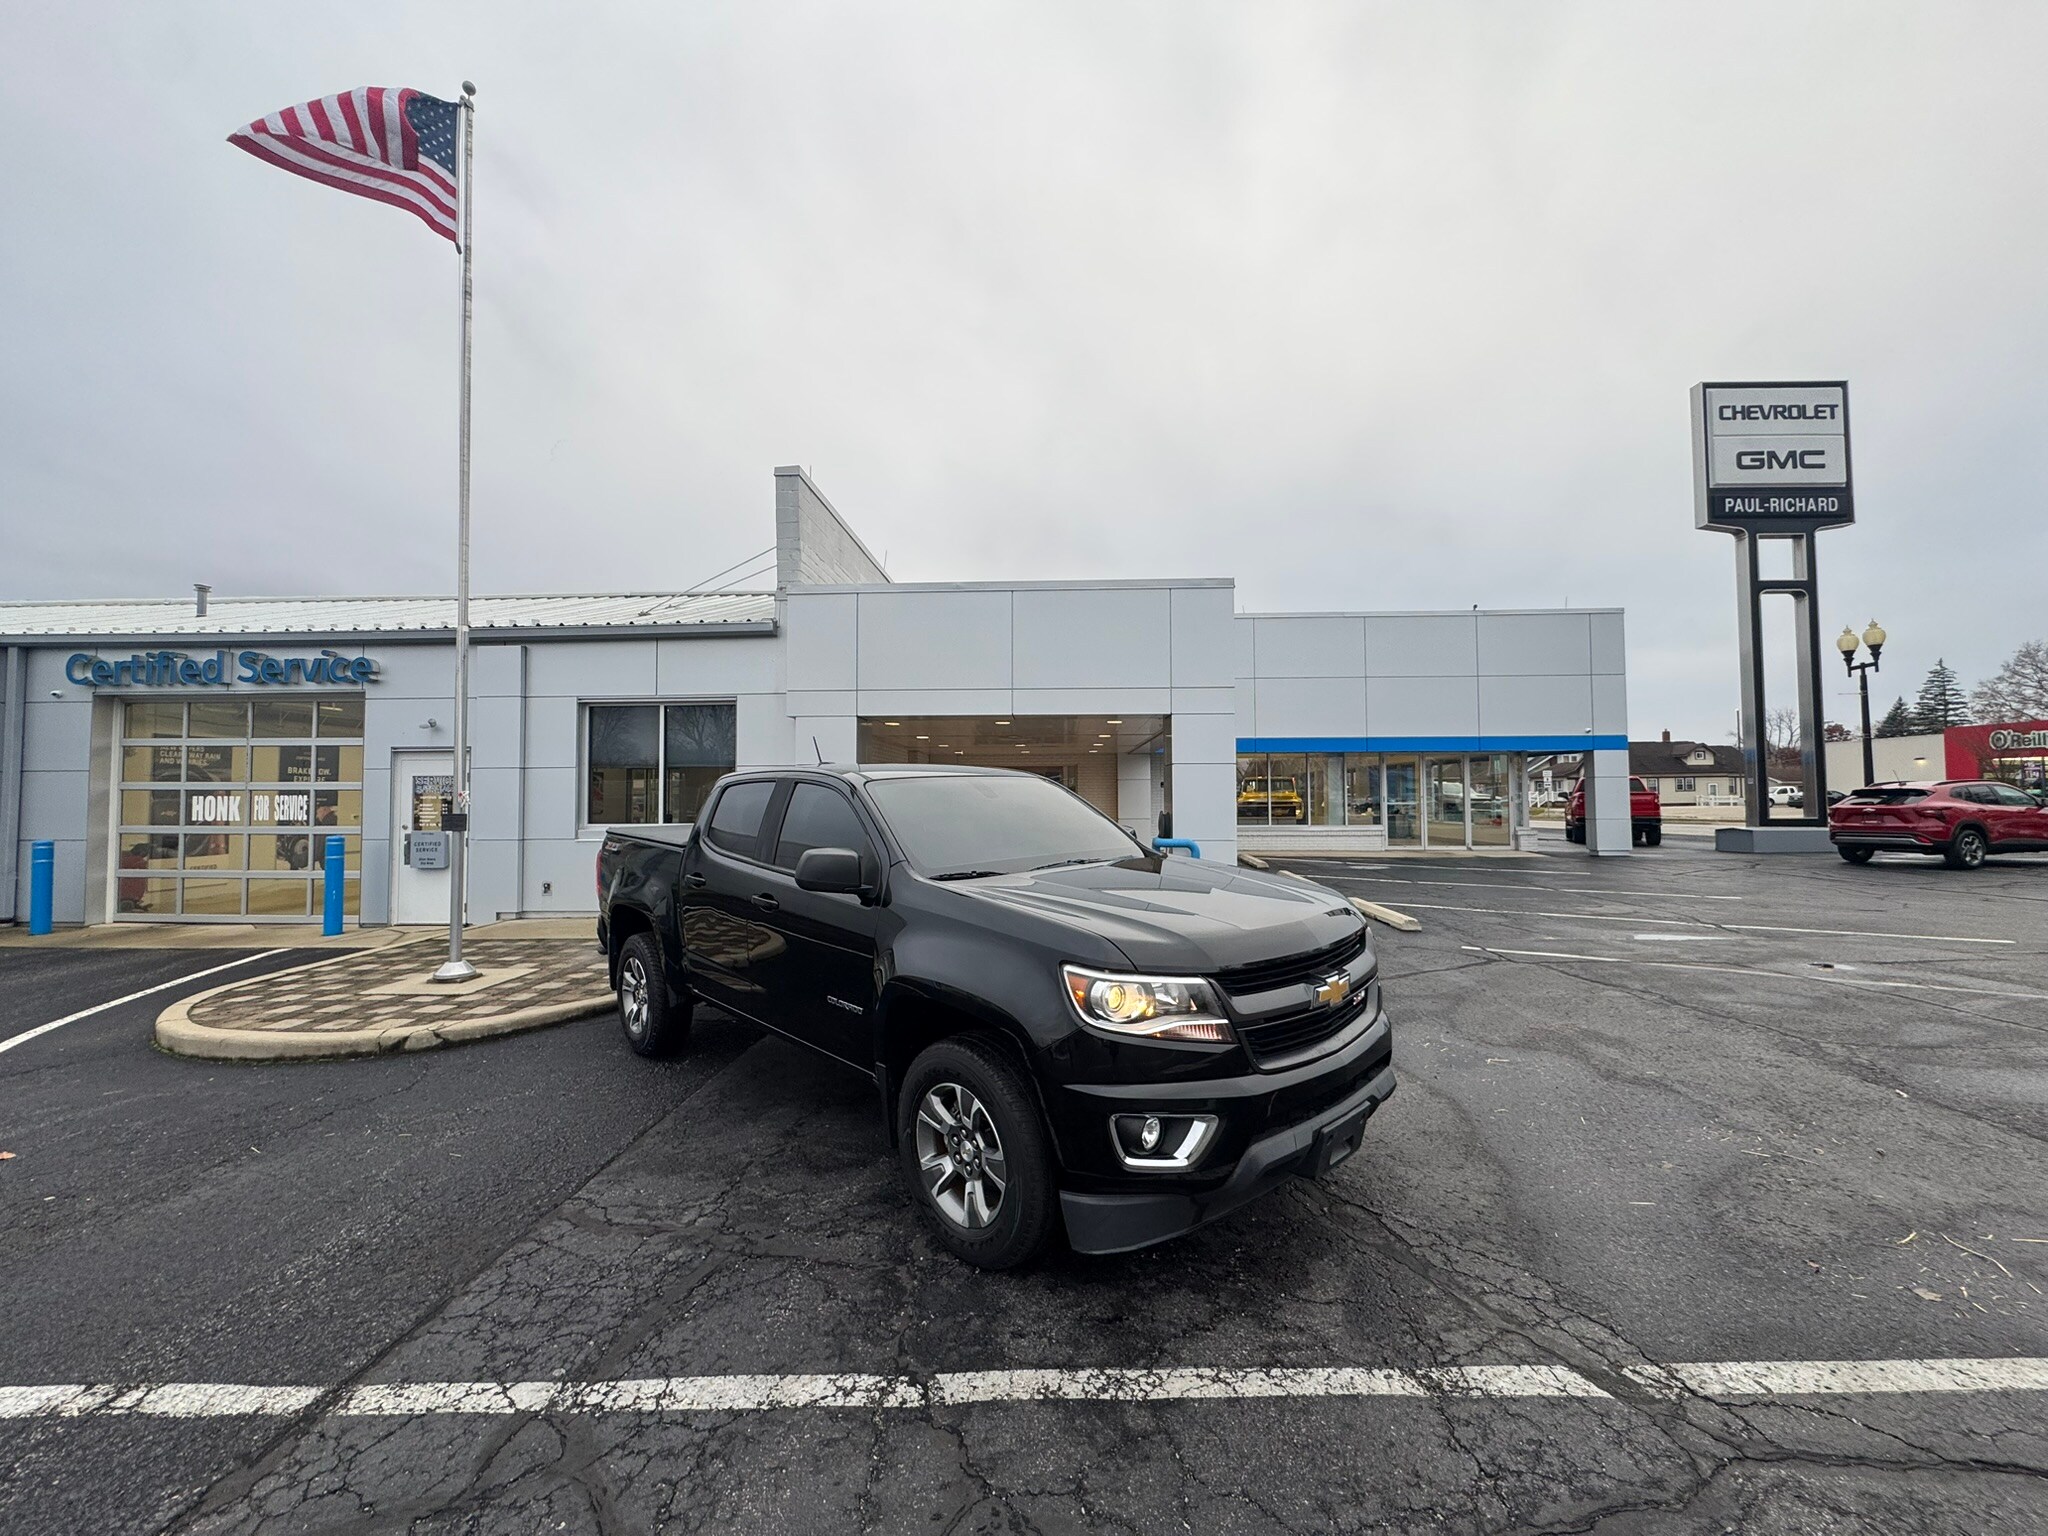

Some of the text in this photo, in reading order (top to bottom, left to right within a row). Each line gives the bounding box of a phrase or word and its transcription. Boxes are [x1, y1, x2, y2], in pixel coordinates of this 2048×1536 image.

[1719, 404, 1838, 420] CHEVROLET
[1736, 450, 1826, 470] GMC
[1725, 497, 1838, 512] PAUL-RICHARD
[65, 650, 374, 685] Certified Service
[1991, 731, 2048, 749] O'Reill
[192, 794, 308, 822] HONK FOR SERVICE
